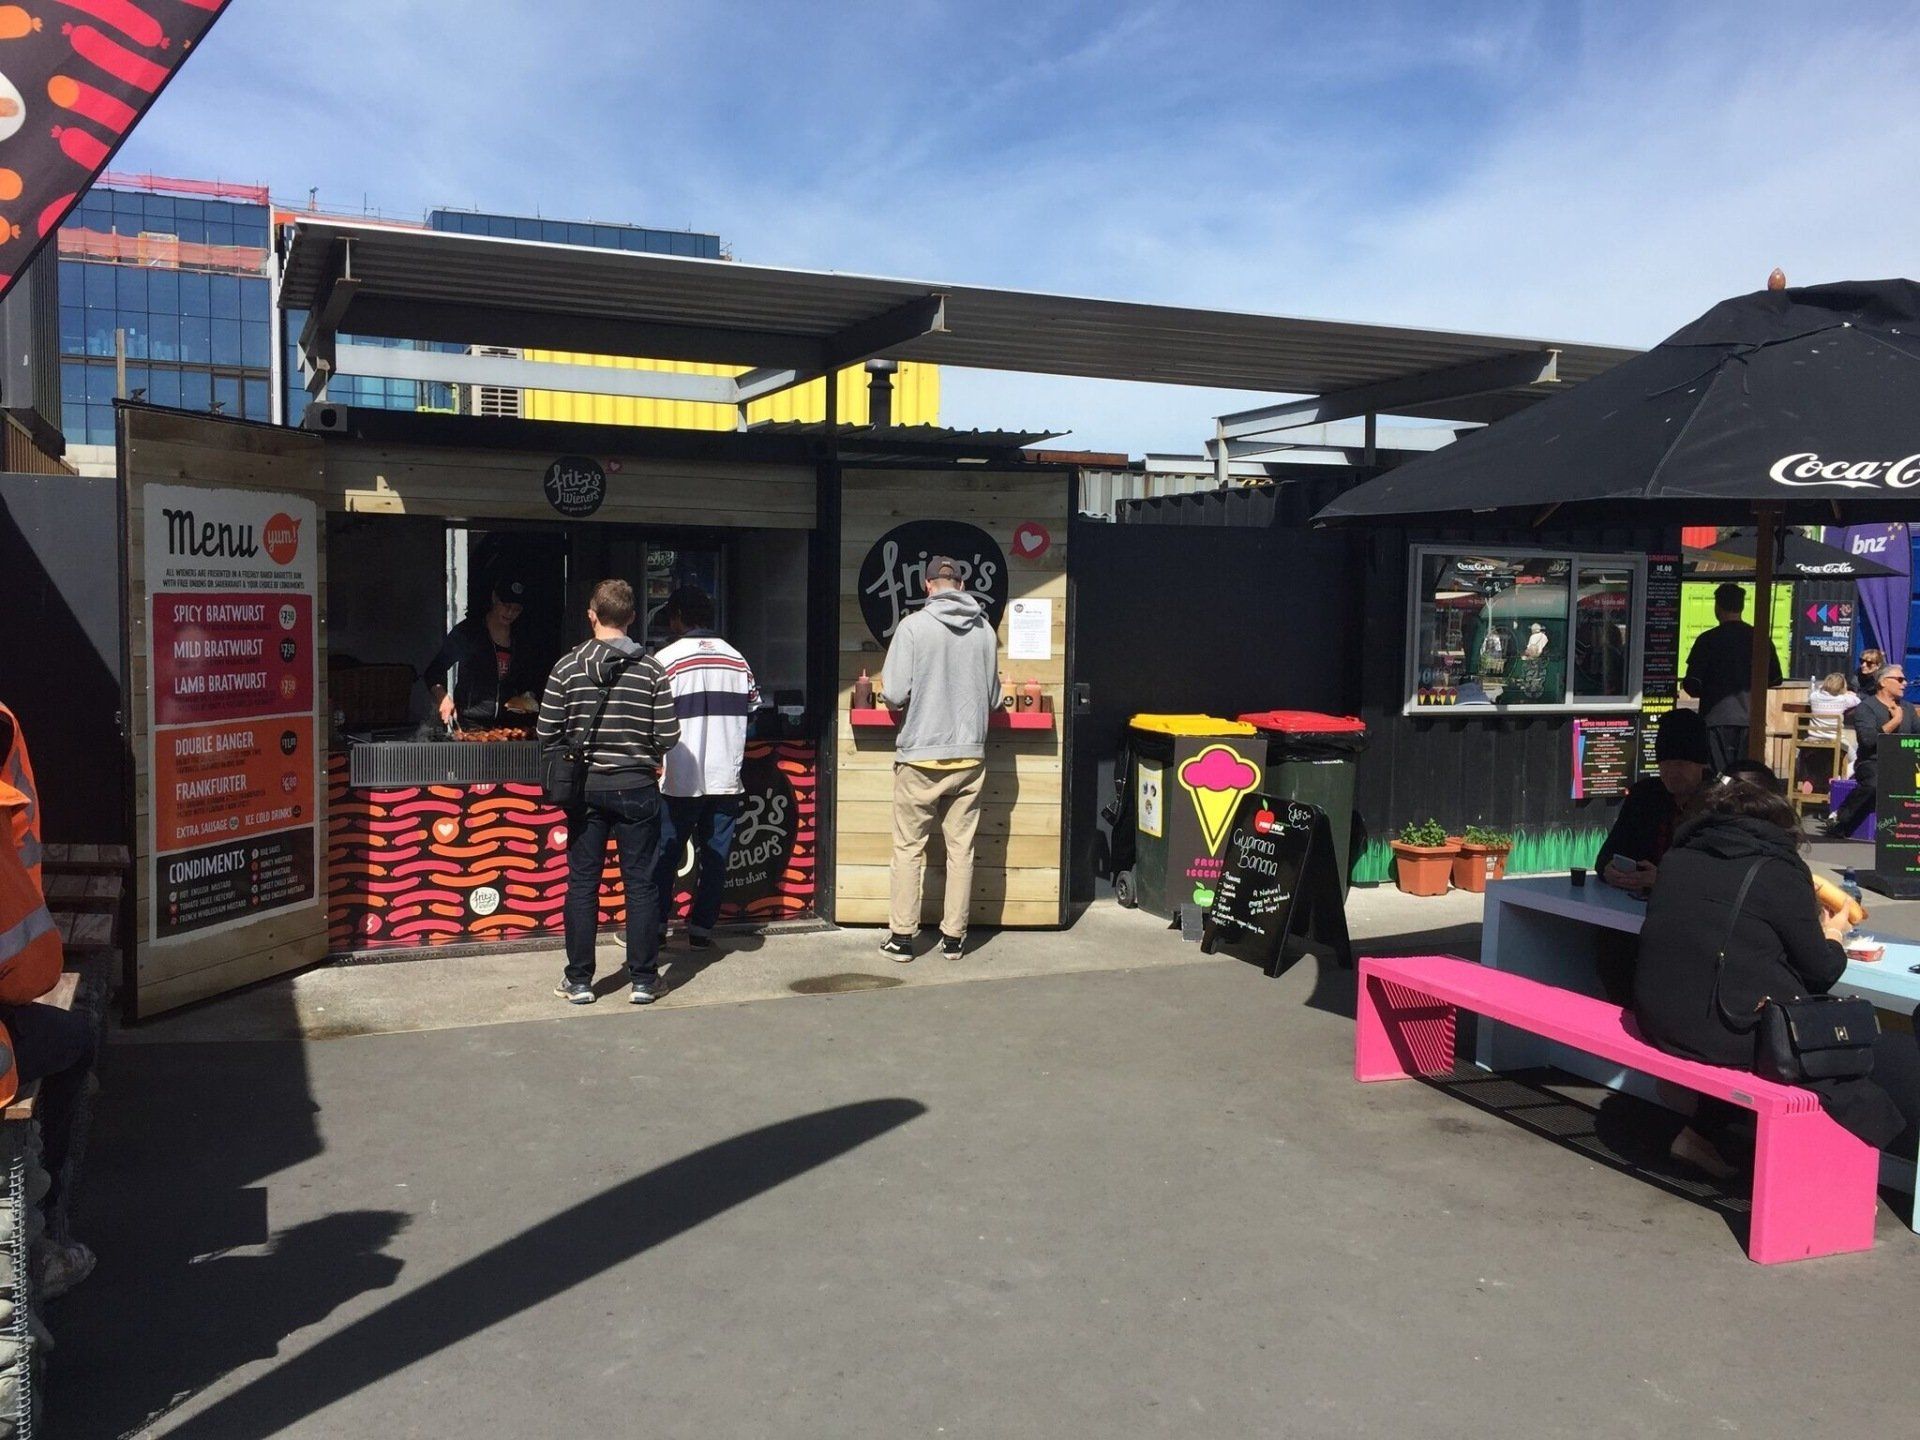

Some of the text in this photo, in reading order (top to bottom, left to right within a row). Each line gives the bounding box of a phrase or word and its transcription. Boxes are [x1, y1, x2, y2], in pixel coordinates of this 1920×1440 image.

[546, 464, 601, 504] fritz's
[1770, 453, 1920, 488] Coca-C
[562, 491, 599, 505] Wieners
[162, 508, 297, 558] Menu yum!
[1852, 534, 1888, 555] bnz
[174, 605, 203, 623] SPICY
[206, 604, 265, 622] BRATWURST
[174, 641, 202, 659] MILD
[204, 638, 264, 658] BRATWURST
[174, 676, 206, 695] LAMB
[208, 672, 268, 693] BRATWURST
[175, 736, 213, 757] DOUBLE
[216, 731, 254, 752] BANGER
[176, 774, 247, 801] FRANKFURTER
[176, 825, 200, 839] EXTRA
[201, 819, 229, 835] SAUSAGE
[245, 815, 255, 826] ICE
[256, 810, 270, 825] COLD
[271, 807, 293, 822] DRINKS
[169, 849, 246, 884] CONDIMENTS
[726, 835, 783, 872] eners
[1237, 849, 1278, 877] Banana
[745, 870, 768, 884] share
